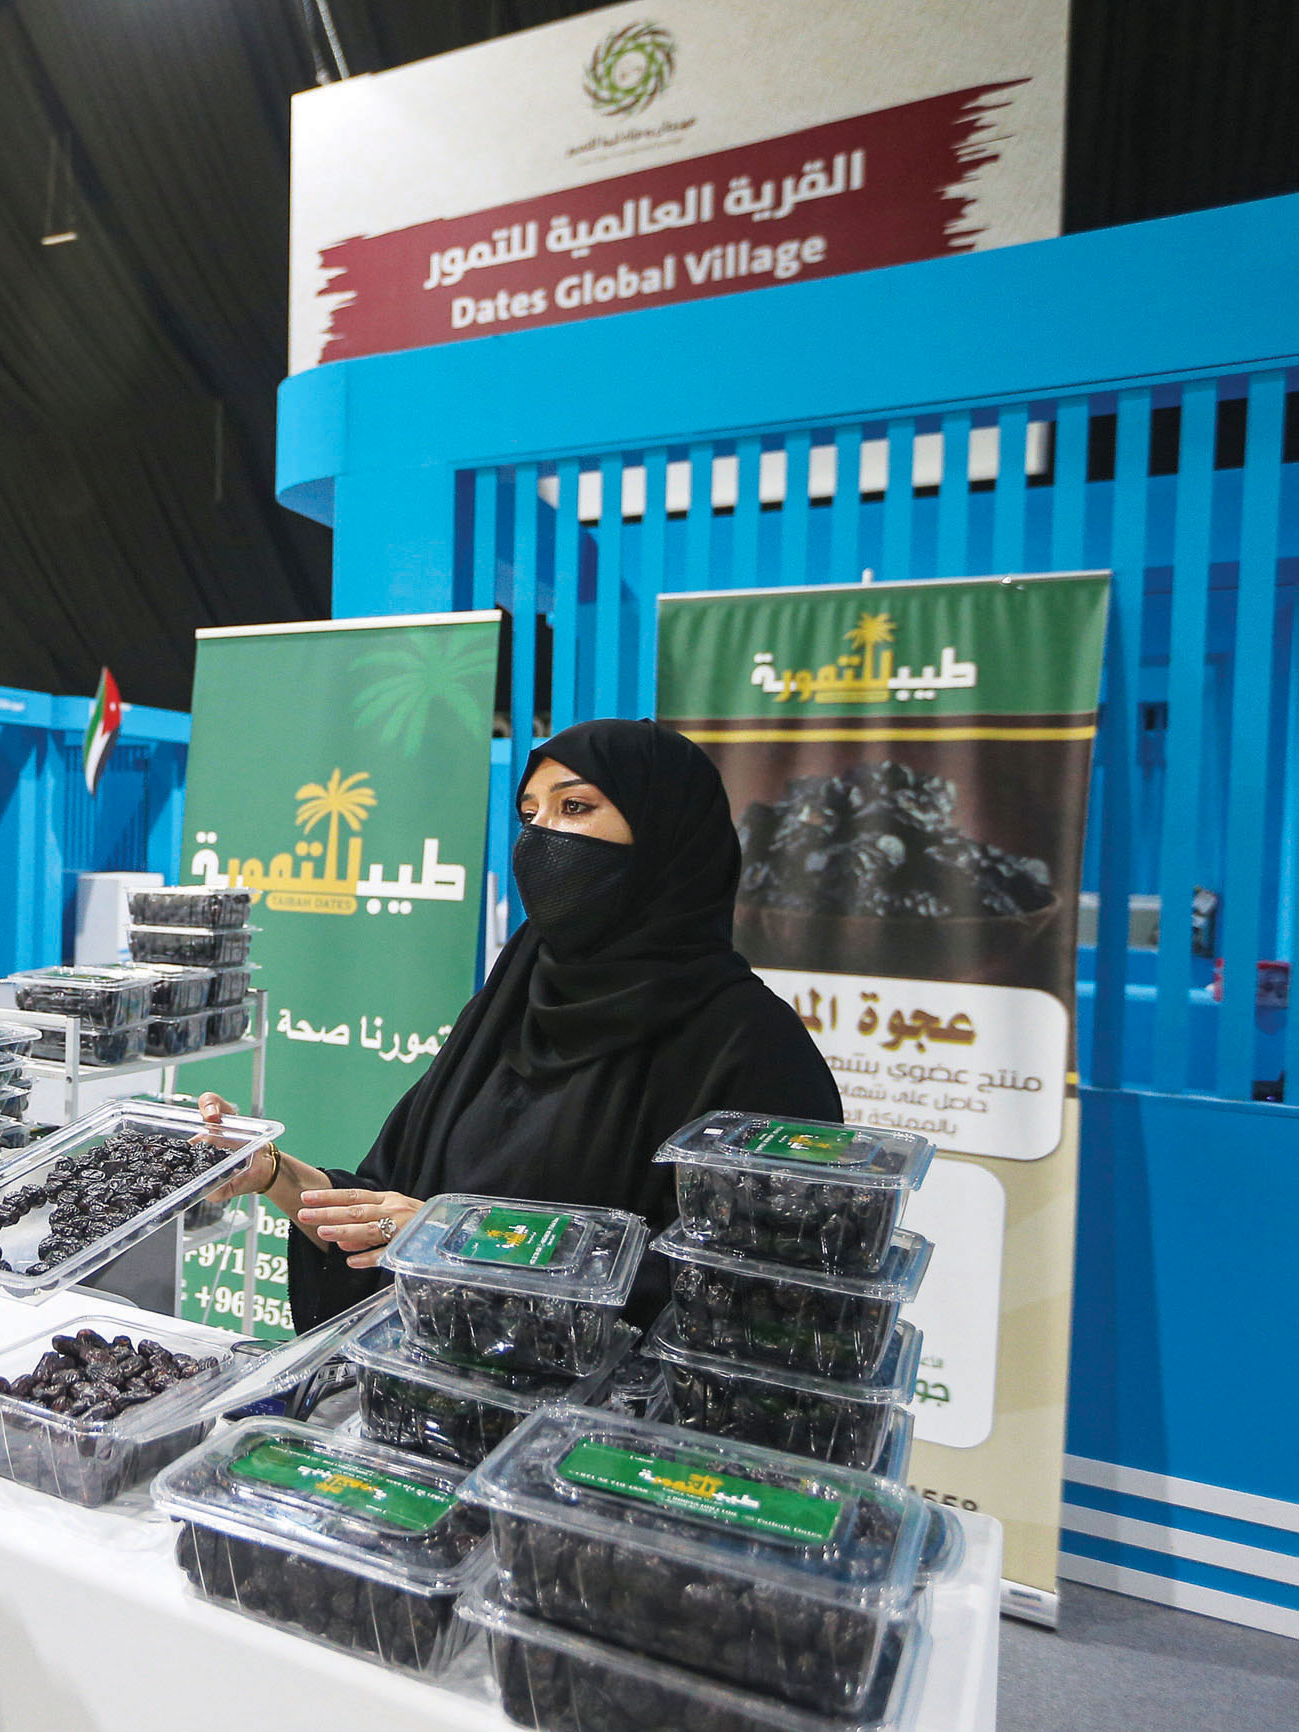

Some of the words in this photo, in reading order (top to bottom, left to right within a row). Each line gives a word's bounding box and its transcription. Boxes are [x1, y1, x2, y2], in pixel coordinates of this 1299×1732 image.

[723, 151, 864, 217] القرية
[546, 182, 715, 256] العالمية
[423, 222, 536, 289] للتمور
[451, 289, 548, 329] Dates
[555, 254, 675, 312] Global
[683, 235, 827, 290] Village
[315, 897, 352, 911] DATES
[277, 1008, 351, 1046] صحة
[857, 991, 976, 1052] عجوة
[892, 1088, 929, 1106] على
[933, 1093, 989, 1113] حاصل
[978, 1069, 1043, 1092] منتج
